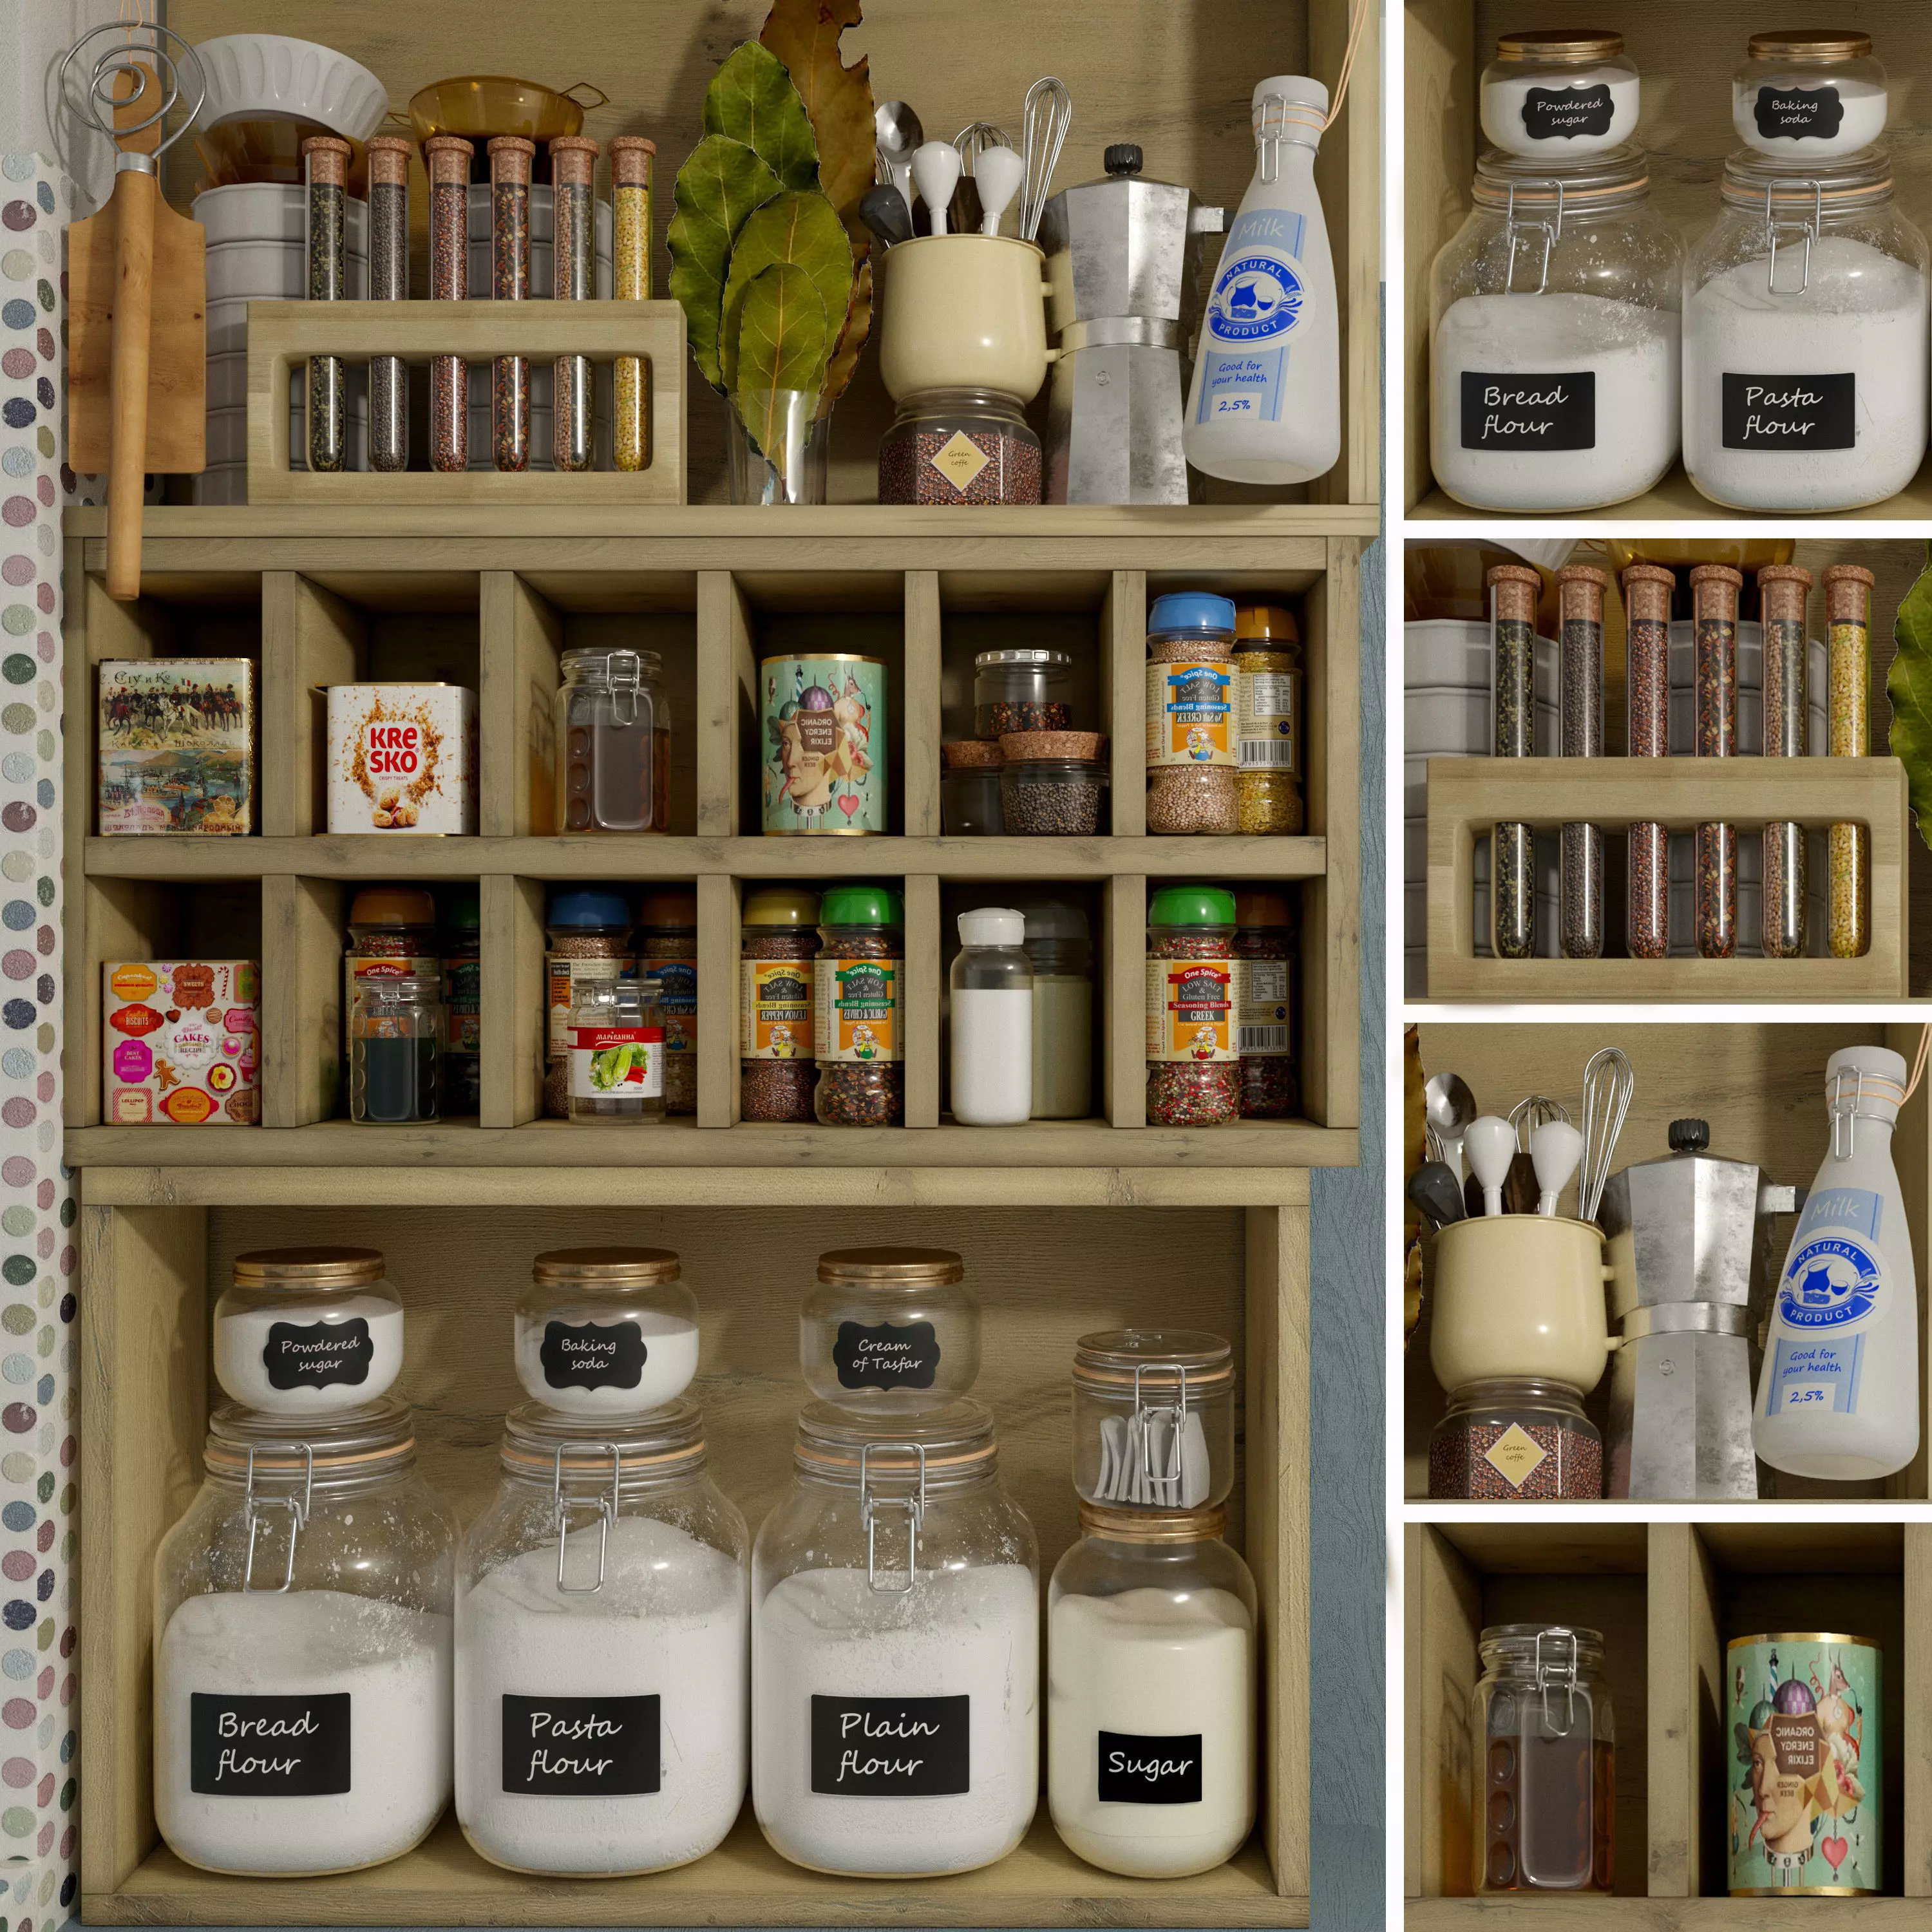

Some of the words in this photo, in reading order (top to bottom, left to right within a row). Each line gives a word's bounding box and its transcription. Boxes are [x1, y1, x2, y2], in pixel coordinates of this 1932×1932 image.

[1537, 98, 1604, 111] Powdered
[1772, 100, 1818, 113] Baking
[1551, 115, 1588, 127] sugar
[1780, 113, 1813, 124] soda
[1238, 216, 1283, 241] Milk
[1226, 260, 1282, 280] NATURAL
[1218, 320, 1278, 336] PRODUCT
[1218, 361, 1244, 373] Good
[1246, 361, 1263, 371] for
[1212, 375, 1233, 388] your
[1235, 373, 1268, 383] health
[1484, 385, 1569, 406] Bread
[1745, 386, 1824, 408] Pasta
[1218, 399, 1251, 412] 2,5%
[1481, 414, 1554, 439] flour
[1743, 414, 1816, 440] flour
[370, 751, 417, 773] SKO
[366, 967, 380, 976] One
[1184, 969, 1200, 978] One
[1182, 980, 1202, 992] LOW
[1203, 980, 1223, 992] SALT
[126, 1016, 149, 1025] BISCUITS
[1190, 1010, 1215, 1020] GREEK
[174, 1034, 210, 1043] CAKES
[1811, 1197, 1861, 1221] Milk
[1797, 1242, 1857, 1264] NATURAL
[1790, 1306, 1853, 1323] PRODUCT
[281, 1336, 361, 1354] Powdered
[561, 1339, 616, 1355] Baking
[858, 1339, 912, 1352] Cream
[1790, 1349, 1816, 1361] Good
[1819, 1348, 1837, 1359] for
[298, 1359, 343, 1373] sugar
[571, 1356, 609, 1370] soda
[852, 1356, 869, 1372] of
[872, 1356, 923, 1373] Tasfar
[1783, 1364, 1804, 1378] your
[1807, 1362, 1842, 1373] health
[1790, 1390, 1824, 1404] 2,5%
[218, 1710, 319, 1738] Bread
[530, 1712, 623, 1740] Pasta
[840, 1712, 940, 1739] Plain
[215, 1748, 301, 1781] flour
[526, 1748, 613, 1782] flour
[836, 1749, 923, 1782] flour
[1108, 1751, 1193, 1782] Sugar
